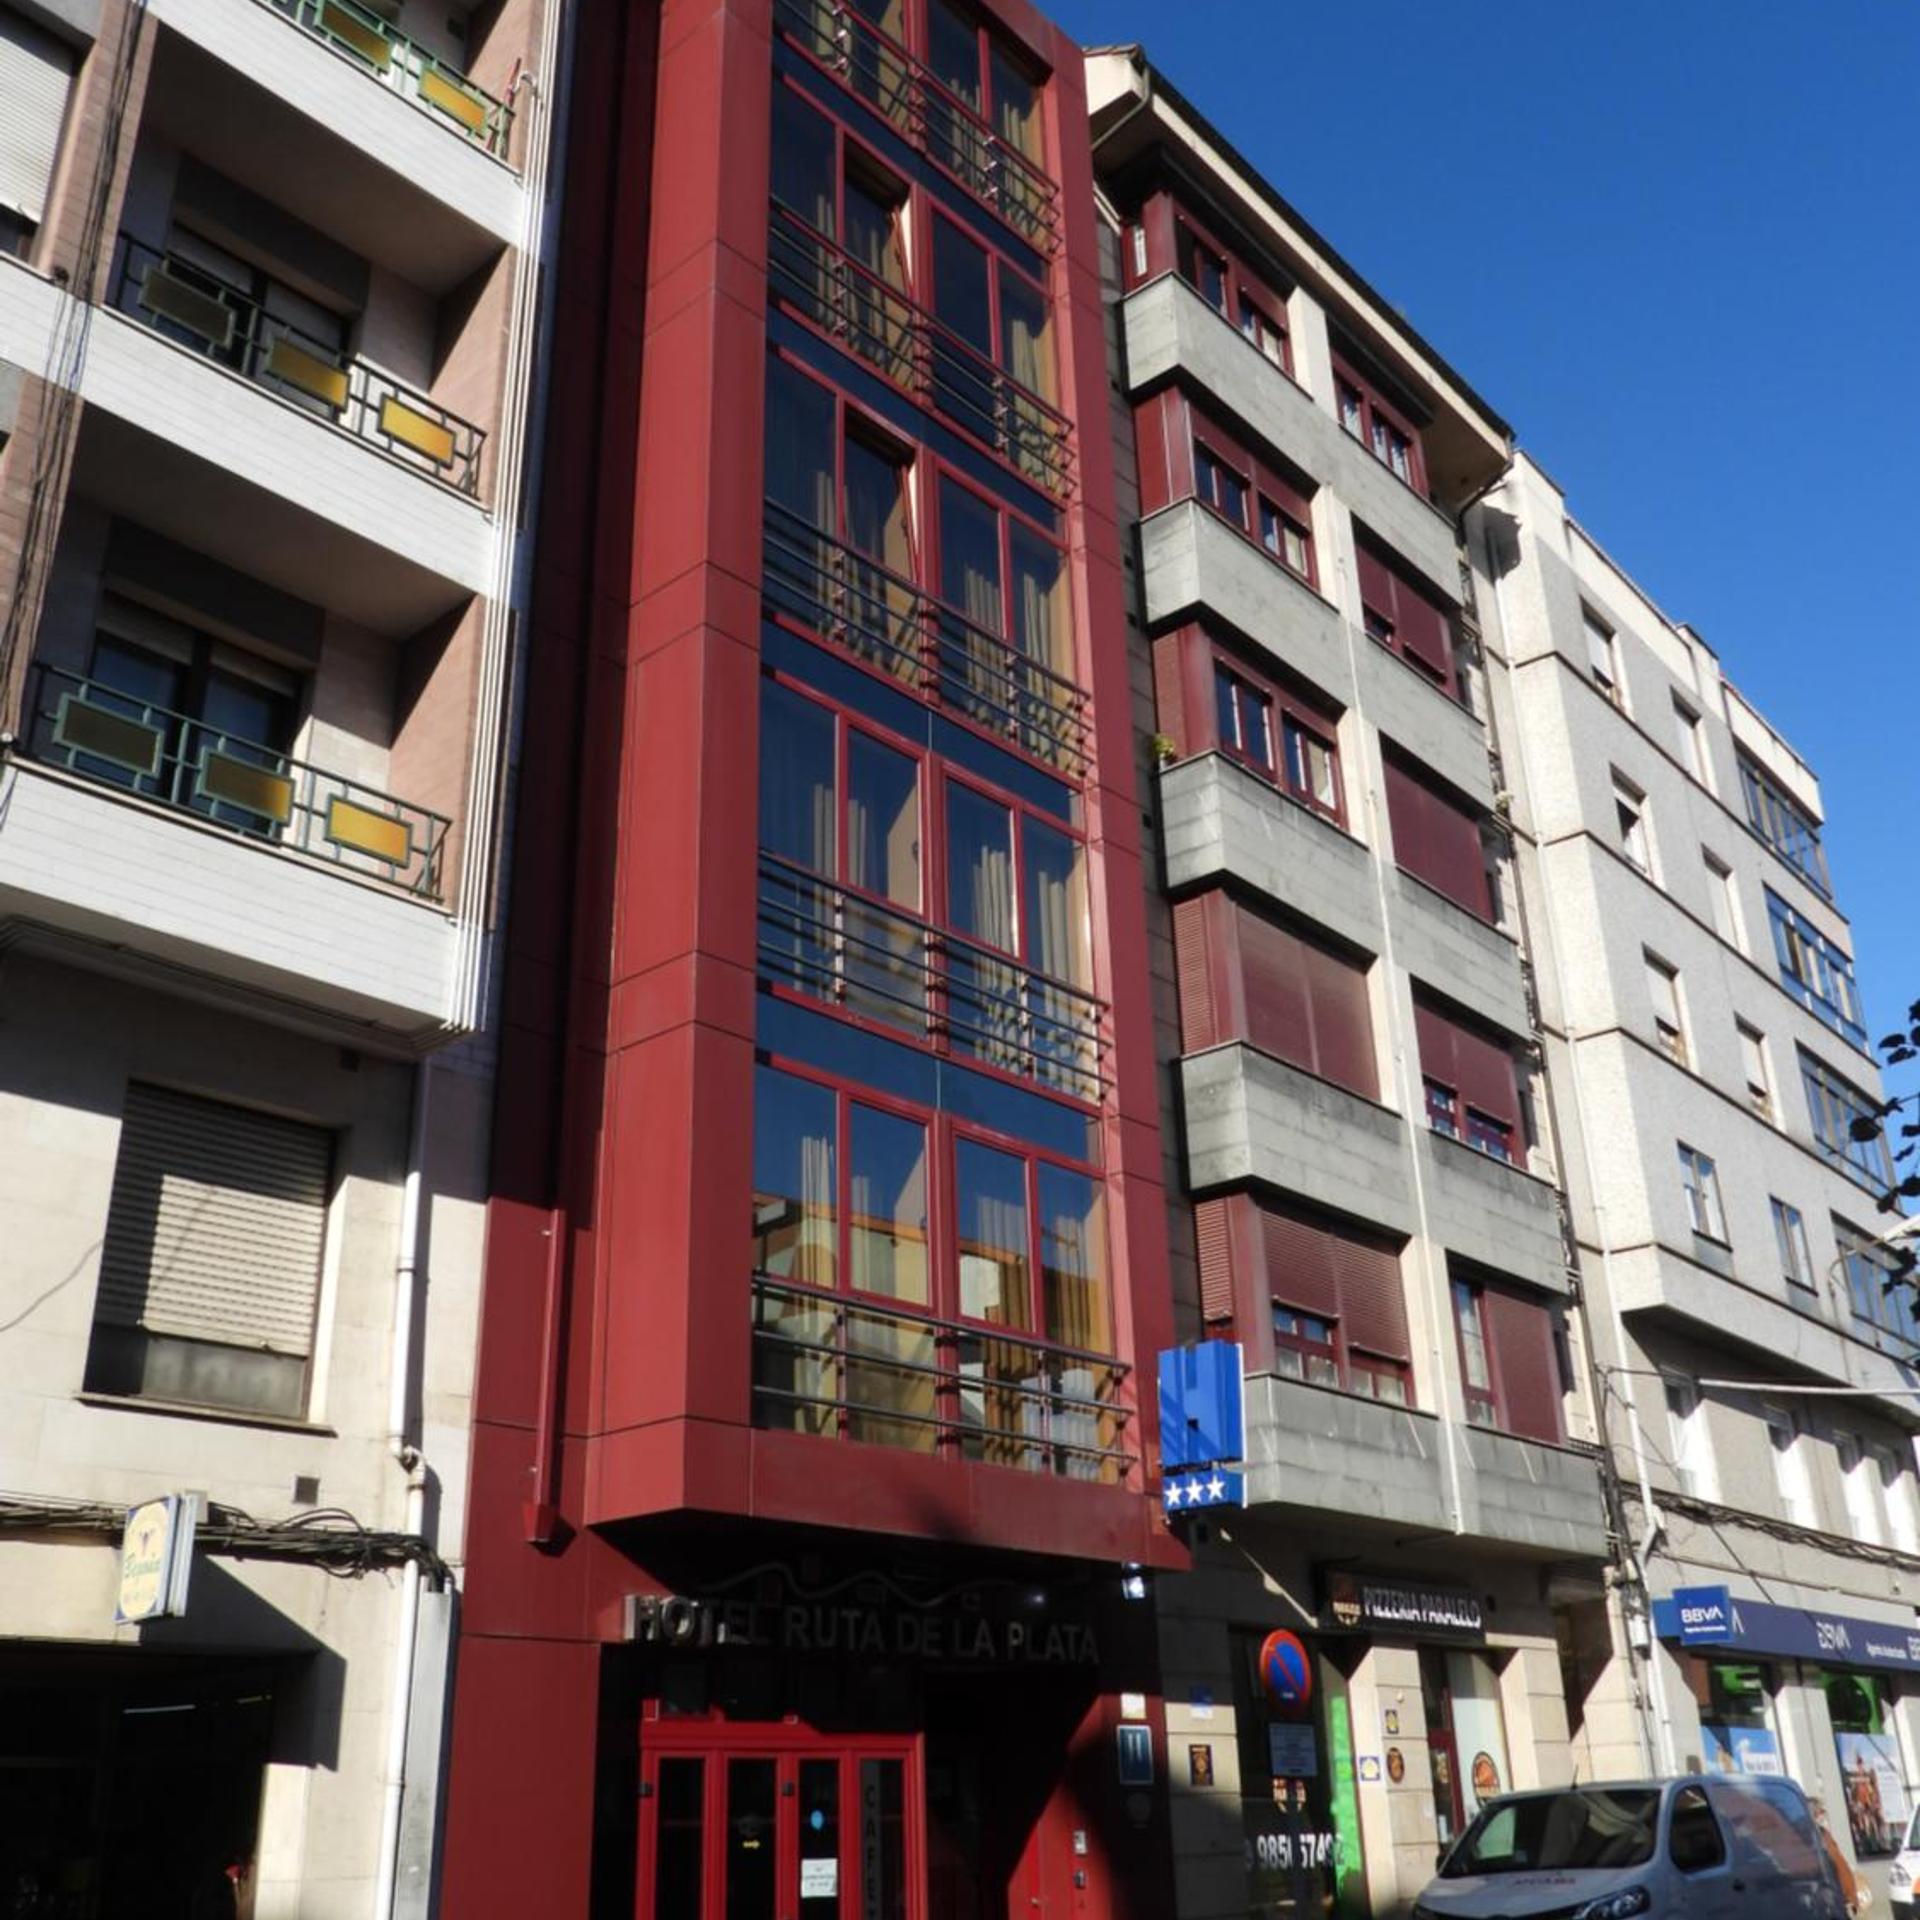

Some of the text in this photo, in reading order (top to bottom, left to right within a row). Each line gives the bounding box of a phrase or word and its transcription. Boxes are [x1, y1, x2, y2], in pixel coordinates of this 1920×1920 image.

[623, 1593, 1100, 1664] HOTEL RUTA DE LA PLATA
[1363, 1587, 1420, 1622] PIZZERIA
[1420, 1594, 1482, 1629] PARALELO
[1681, 1605, 1724, 1624] BBVA
